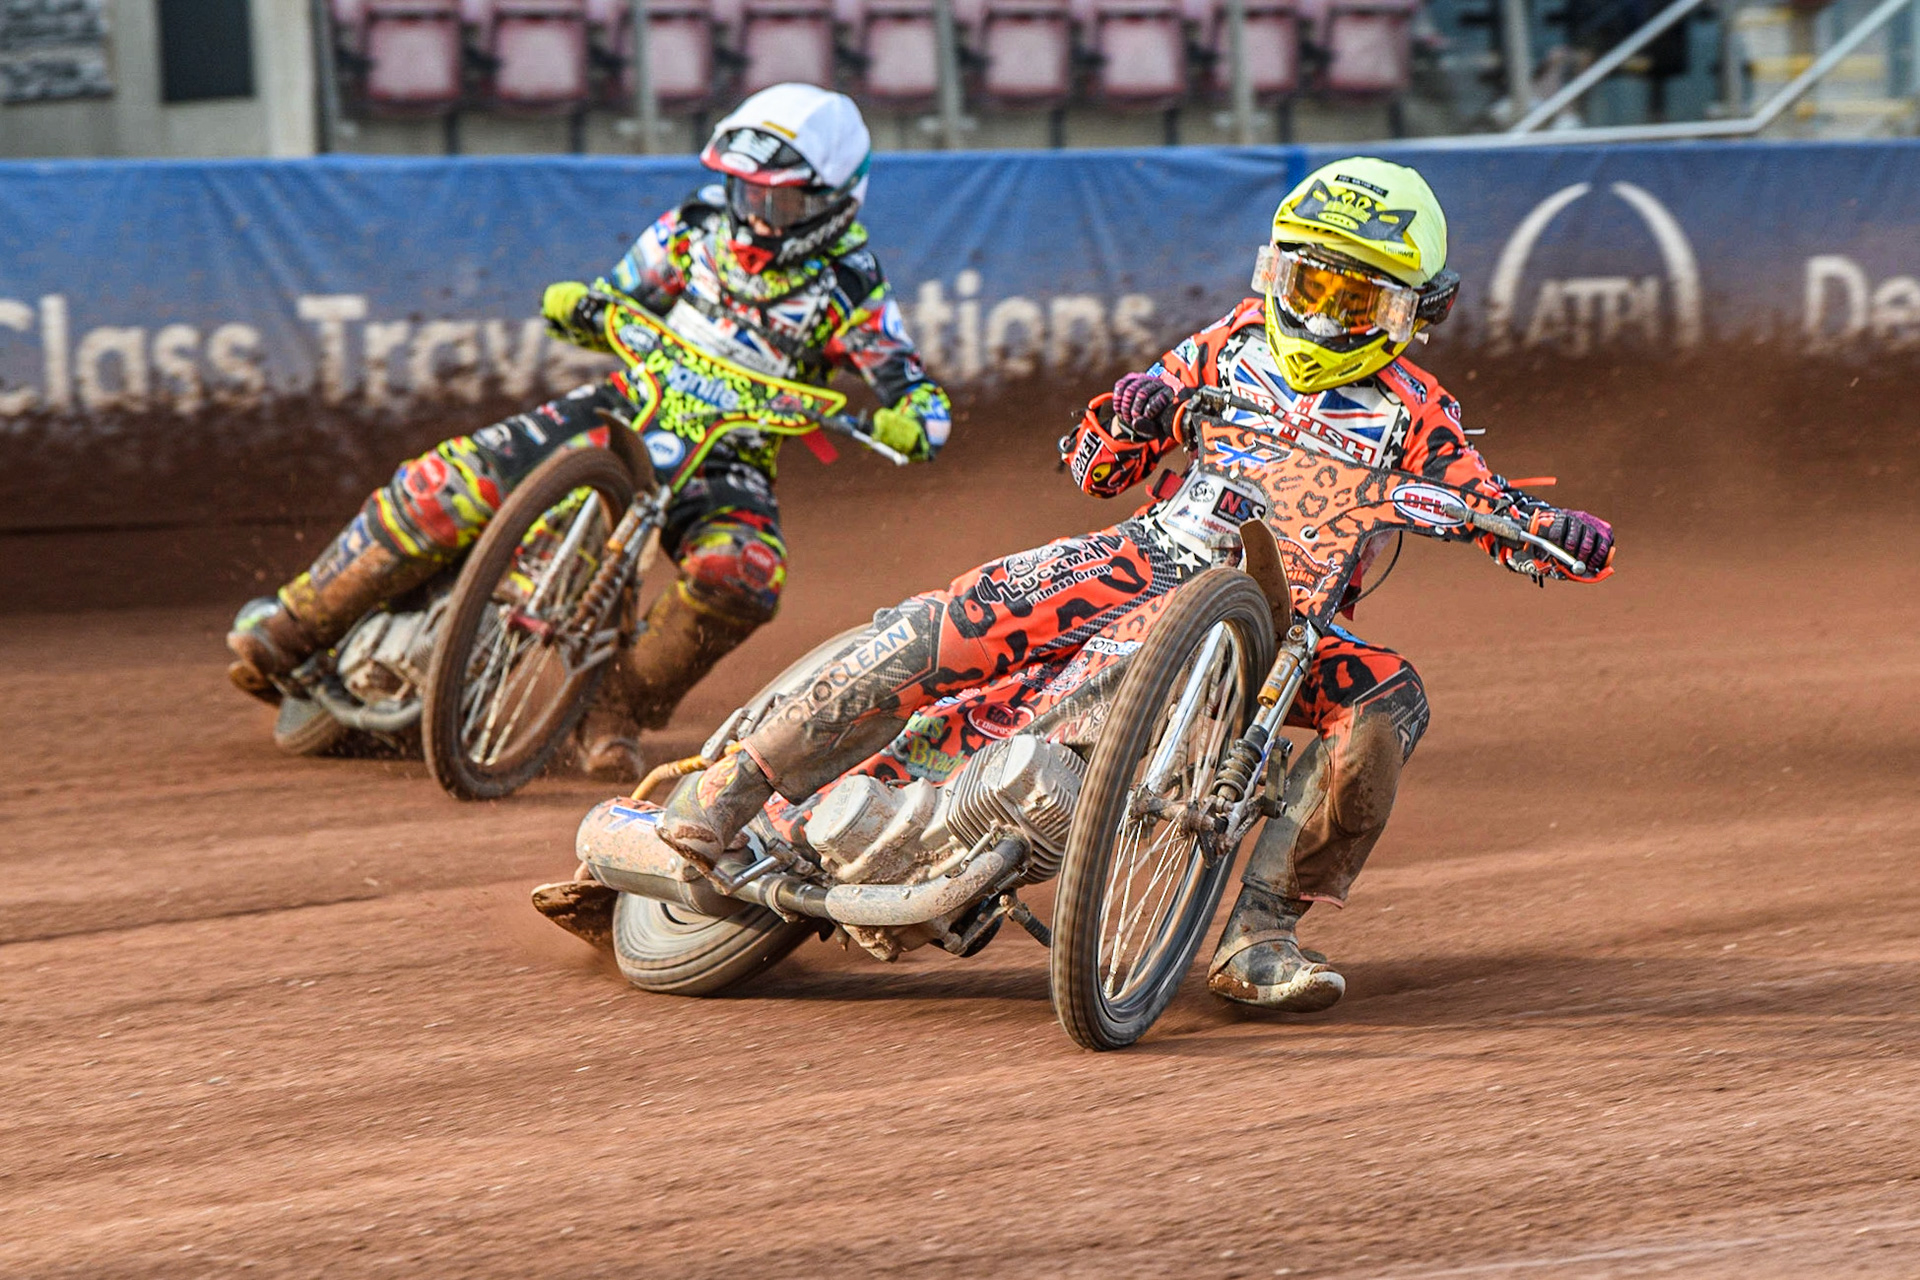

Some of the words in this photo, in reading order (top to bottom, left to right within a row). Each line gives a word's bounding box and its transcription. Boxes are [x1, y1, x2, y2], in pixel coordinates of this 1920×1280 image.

[297, 296, 615, 407] Trave
[1404, 492, 1460, 520] BEL
[1000, 535, 1111, 600] LUCKMAN
[1028, 578, 1074, 605] Fitness
[1074, 563, 1112, 583] Group
